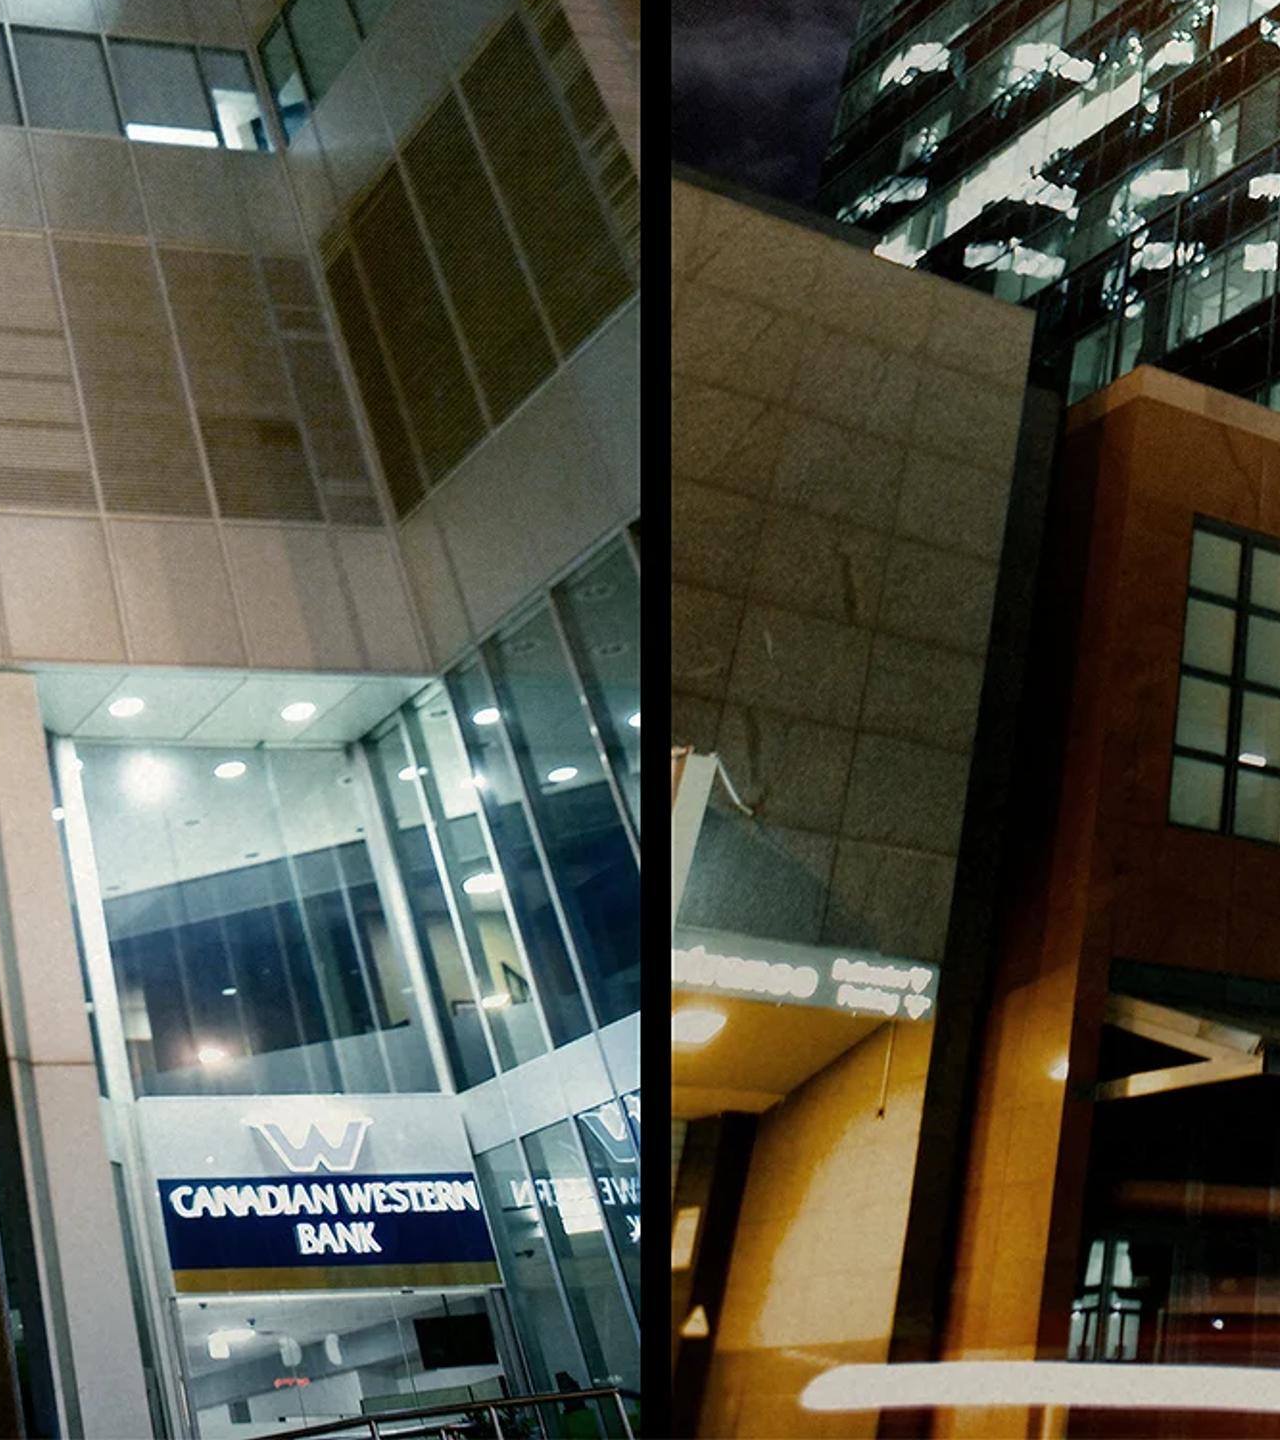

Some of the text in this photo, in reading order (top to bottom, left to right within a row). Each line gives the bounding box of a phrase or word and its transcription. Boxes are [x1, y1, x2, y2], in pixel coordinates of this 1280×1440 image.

[170, 1180, 481, 1218] CANADIAN WESTERN
[297, 1222, 382, 1255] BANK
